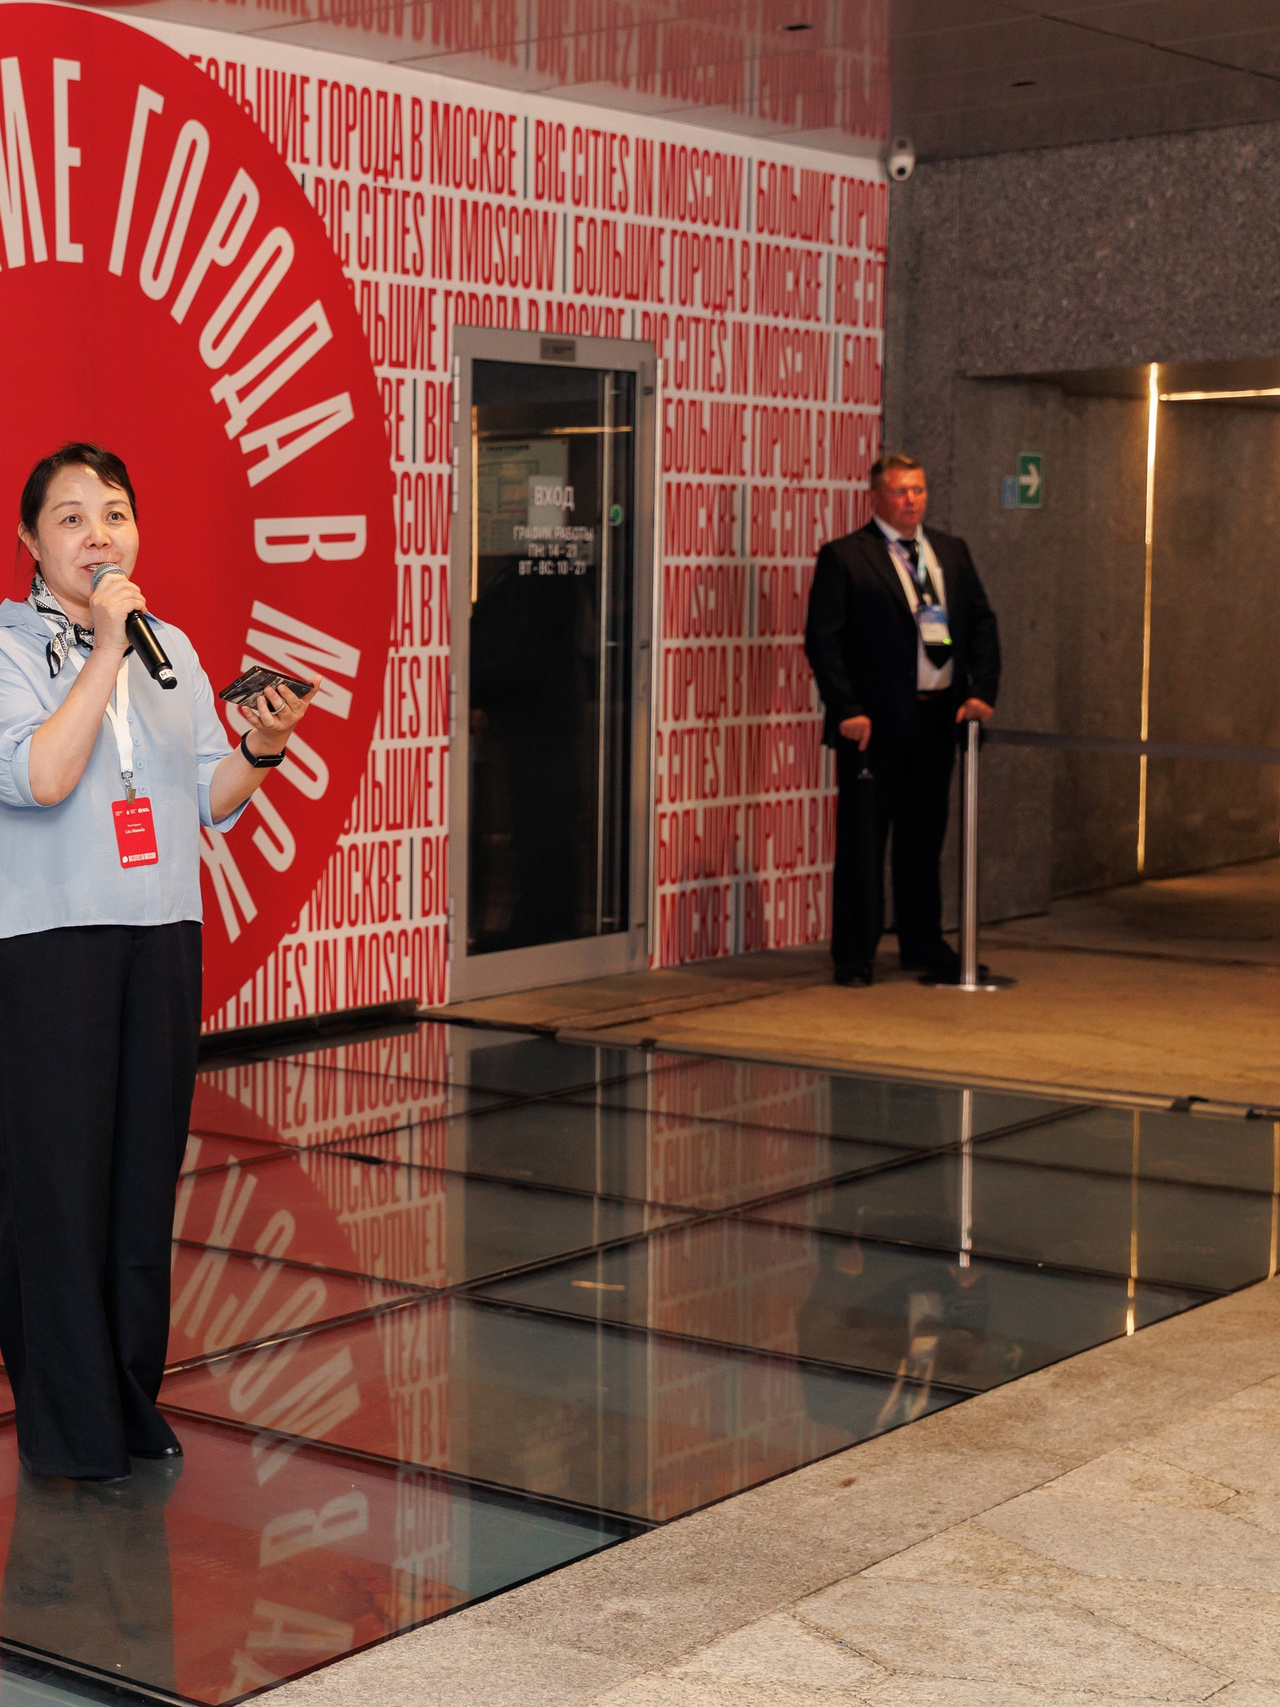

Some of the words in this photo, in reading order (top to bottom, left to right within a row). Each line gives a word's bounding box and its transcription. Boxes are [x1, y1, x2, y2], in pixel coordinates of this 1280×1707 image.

[189, 54, 310, 165] ЬШИЕ
[318, 78, 404, 184] ГОРОДА
[411, 96, 423, 182] В
[431, 100, 517, 197] МОСКВЕ
[534, 119, 566, 204] BIG
[571, 126, 629, 213] CITIES
[634, 136, 654, 217] IN
[659, 141, 743, 231] MOSCOW
[756, 160, 835, 245] БОЛЬШИЕ
[358, 180, 425, 277] CITIES
[431, 195, 453, 281] IN
[459, 199, 557, 292] MOSCOW
[573, 215, 665, 304] БОЛЬШИЕ
[670, 229, 736, 316] ГОРОДА
[108, 84, 354, 488] ГОРОДА
[675, 314, 727, 393] CITIES
[731, 321, 749, 395] IN
[663, 397, 747, 476] БОЛЬШИЕ
[751, 404, 812, 484] ГОРОДА
[254, 515, 367, 564] В
[396, 471, 452, 556] COW
[534, 485, 575, 512] ВХОД
[664, 481, 737, 557] МОСКВЕ
[663, 564, 746, 639] MOSCOW
[663, 644, 728, 725] ГОРОДА
[200, 600, 361, 944] МОСК
[343, 746, 433, 836] ЬШИЕ
[658, 805, 740, 886] БОЛЬШИЕ
[315, 938, 338, 1015] IN
[344, 925, 448, 1010] MOSCOW
